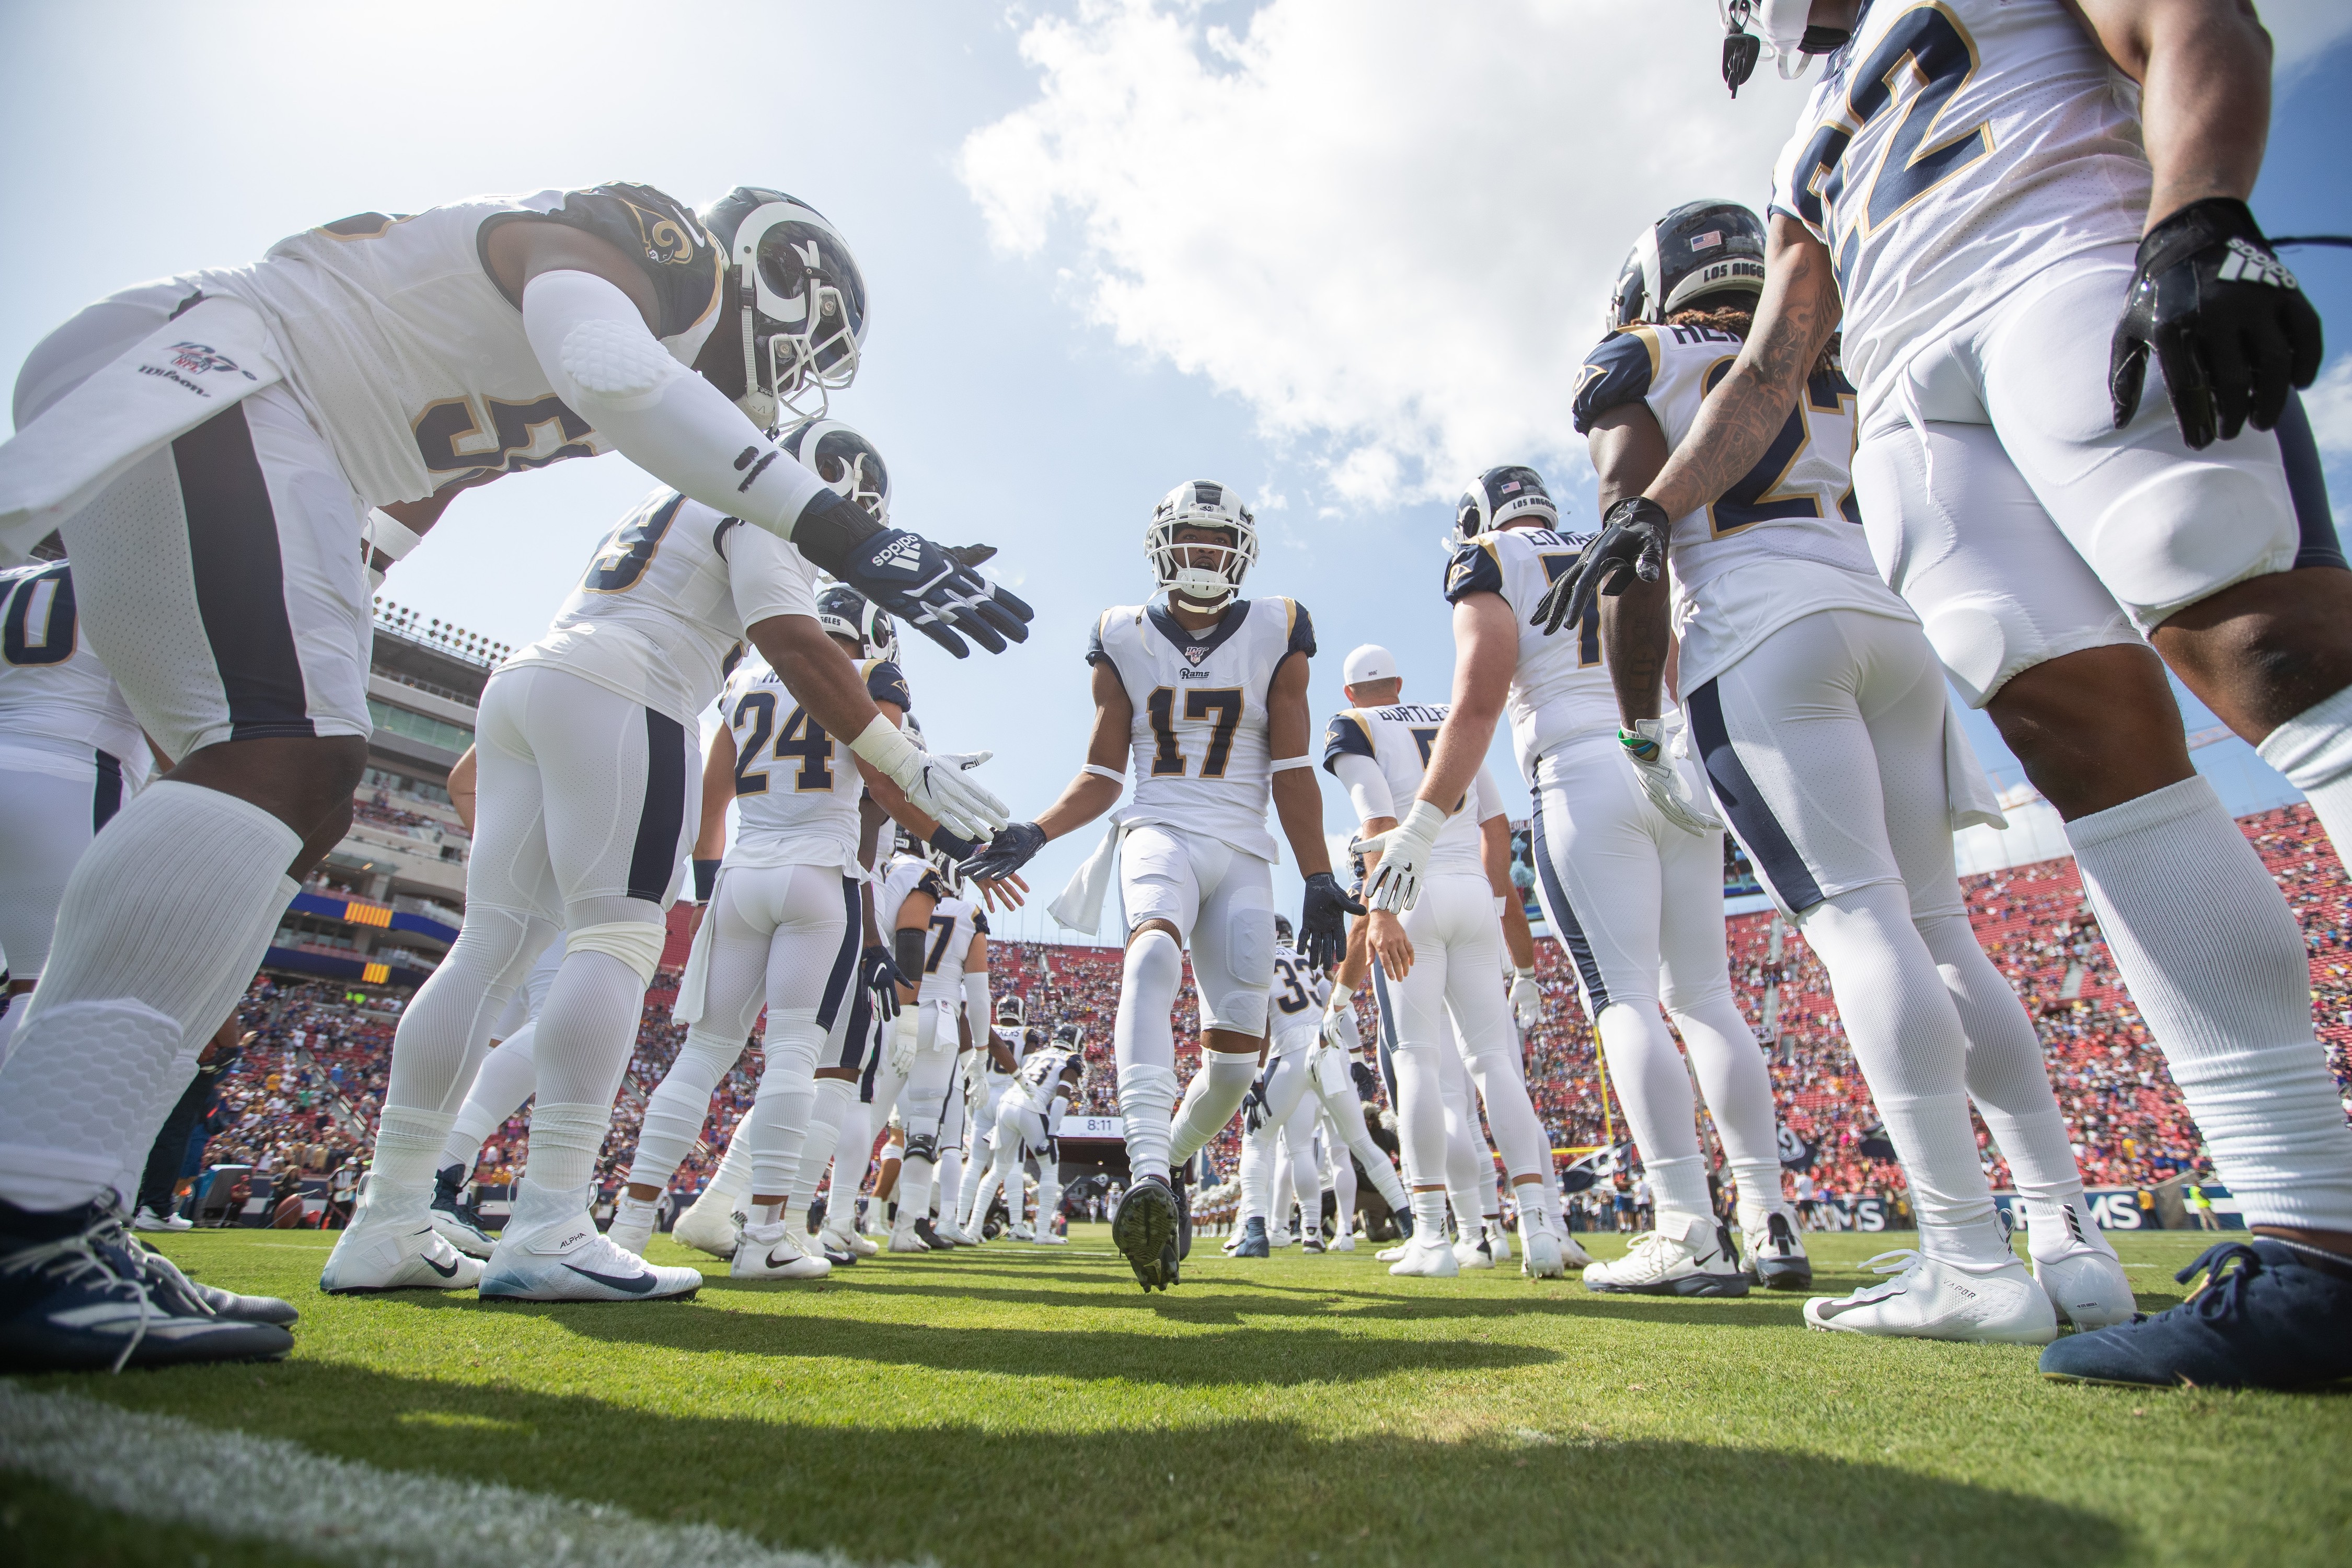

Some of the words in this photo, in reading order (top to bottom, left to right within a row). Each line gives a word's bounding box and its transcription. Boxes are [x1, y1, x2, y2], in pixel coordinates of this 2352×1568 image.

[1704, 264, 1728, 282] LOS
[1513, 498, 1527, 510] LOS
[872, 535, 918, 567] adidas
[1180, 668, 1210, 679] Rams
[1146, 686, 1244, 779] 17
[733, 690, 835, 799] 24
[1087, 1119, 1112, 1131] 8:11
[2009, 1194, 2141, 1230] RMS
[560, 1232, 587, 1250] ALPHA
[1943, 1278, 1976, 1299] VAPOR
